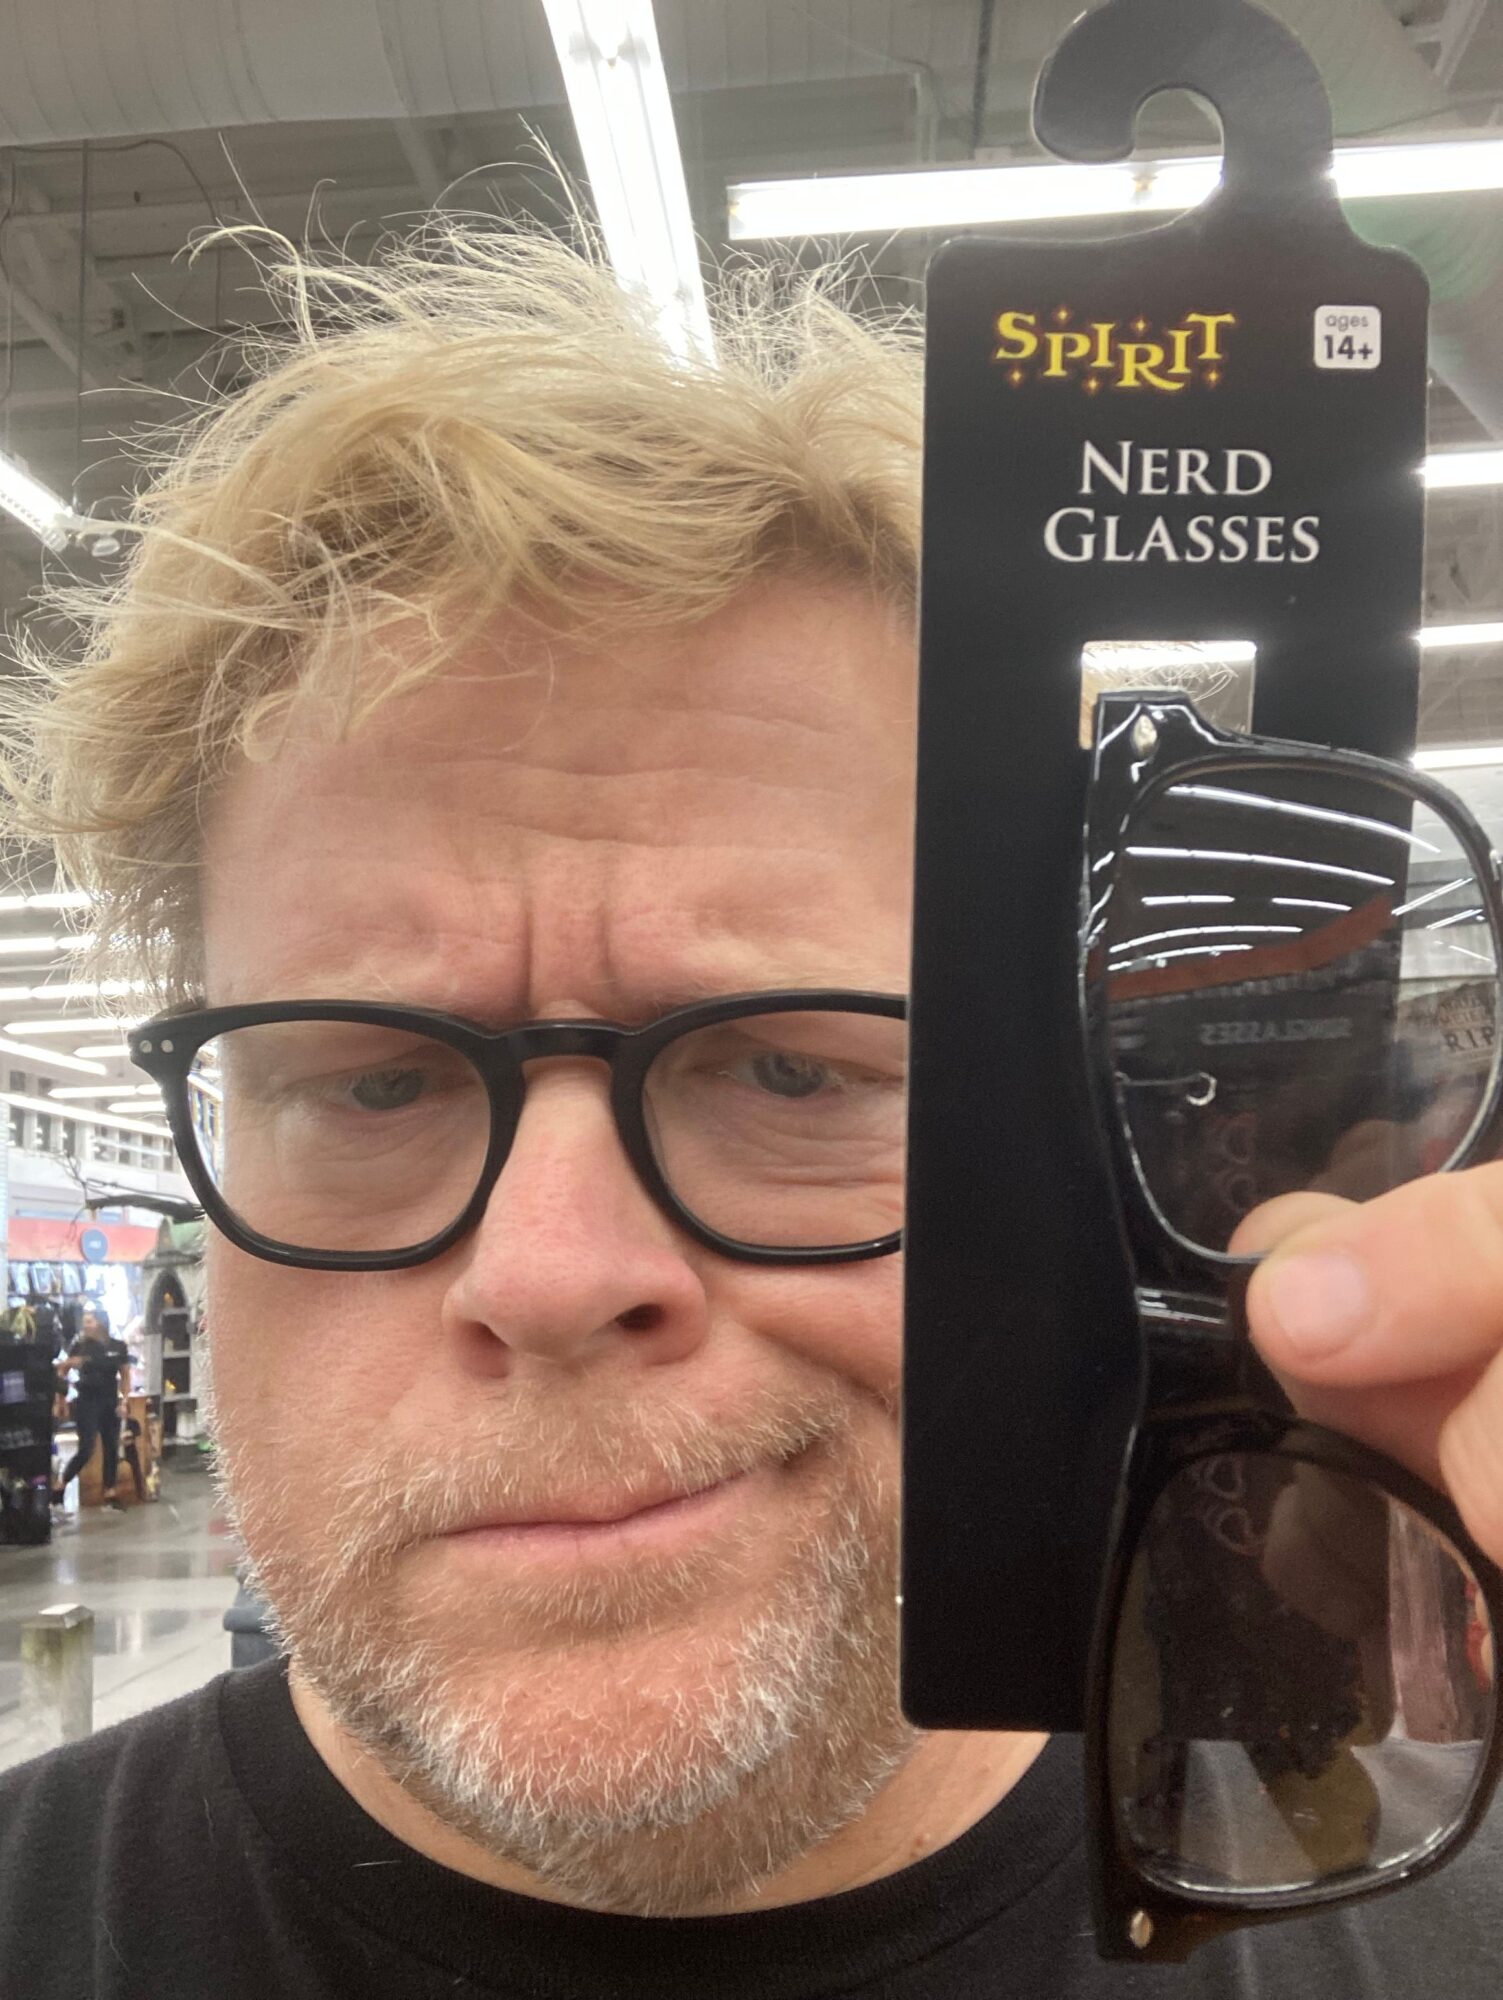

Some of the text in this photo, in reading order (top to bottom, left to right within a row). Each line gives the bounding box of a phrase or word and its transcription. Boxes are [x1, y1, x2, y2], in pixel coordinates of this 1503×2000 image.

[996, 311, 1235, 391] SPIRIT
[1324, 334, 1373, 360] 14+
[1325, 315, 1369, 332] ages
[1078, 440, 1272, 496] NERD
[1043, 507, 1320, 564] GLASSES
